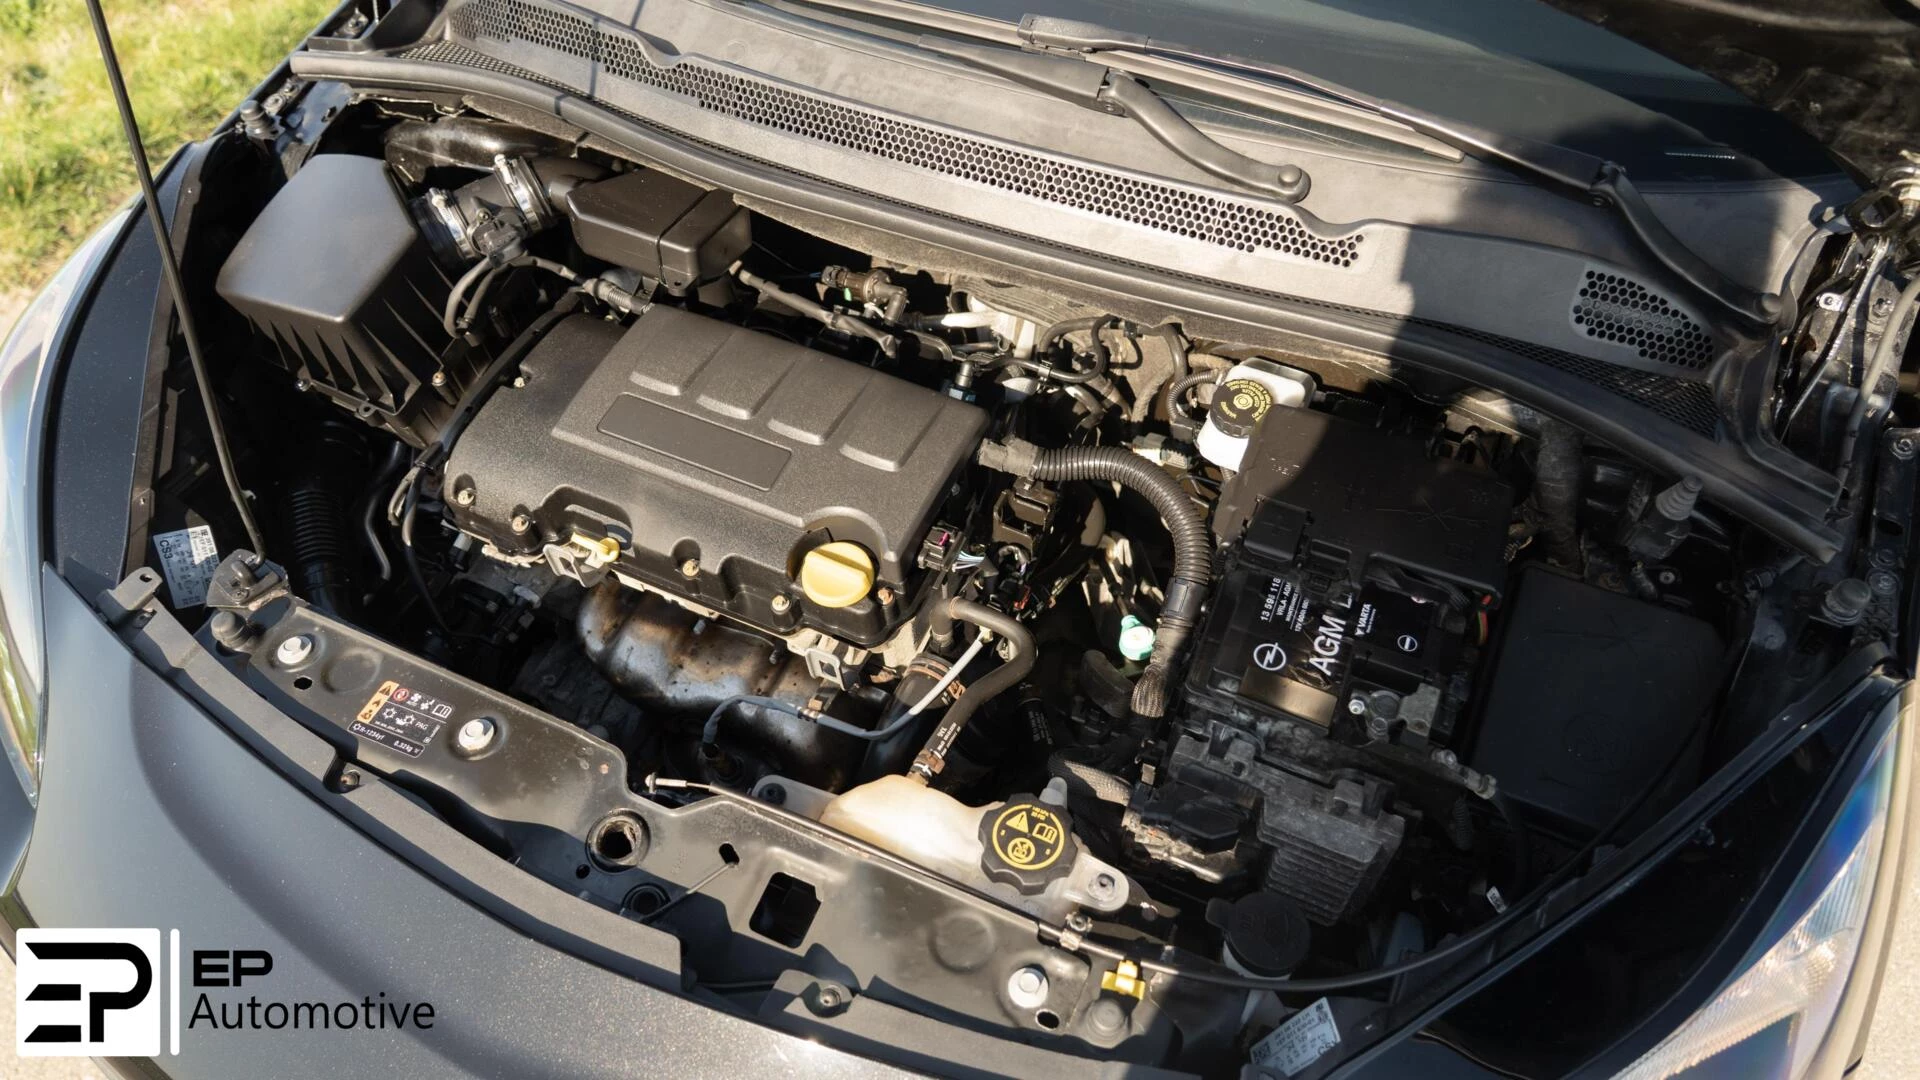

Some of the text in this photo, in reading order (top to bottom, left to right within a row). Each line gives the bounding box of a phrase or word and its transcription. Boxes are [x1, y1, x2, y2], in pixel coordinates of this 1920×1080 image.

[160, 540, 174, 560] CS3
[1260, 610, 1271, 621] 13
[1357, 603, 1372, 628] VARTA
[1309, 614, 1347, 676] AGM
[415, 721, 429, 731] PAG
